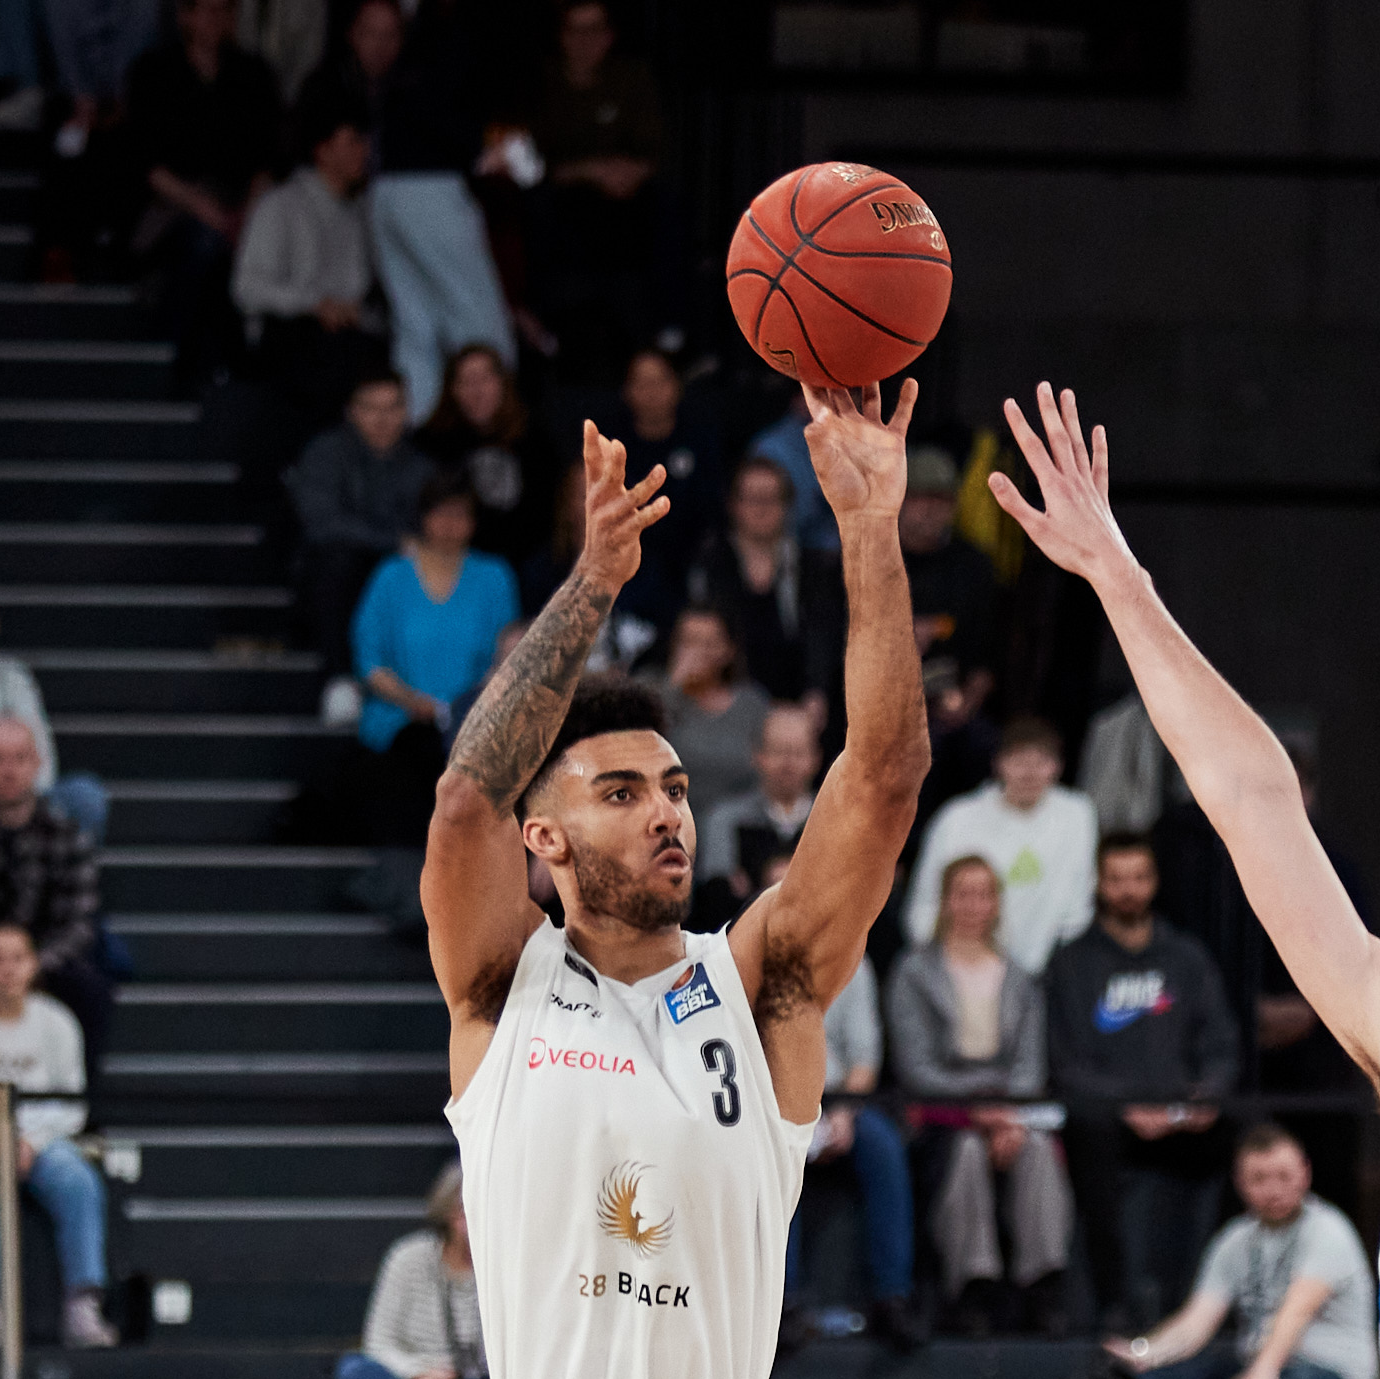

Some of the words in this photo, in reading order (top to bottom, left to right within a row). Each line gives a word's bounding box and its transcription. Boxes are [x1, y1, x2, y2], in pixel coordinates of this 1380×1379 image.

[676, 991, 714, 1020] BBL
[549, 1048, 636, 1075] VEOLIA
[700, 1038, 742, 1127] 3
[578, 1273, 607, 1298] 28
[618, 1271, 690, 1308] BACK
